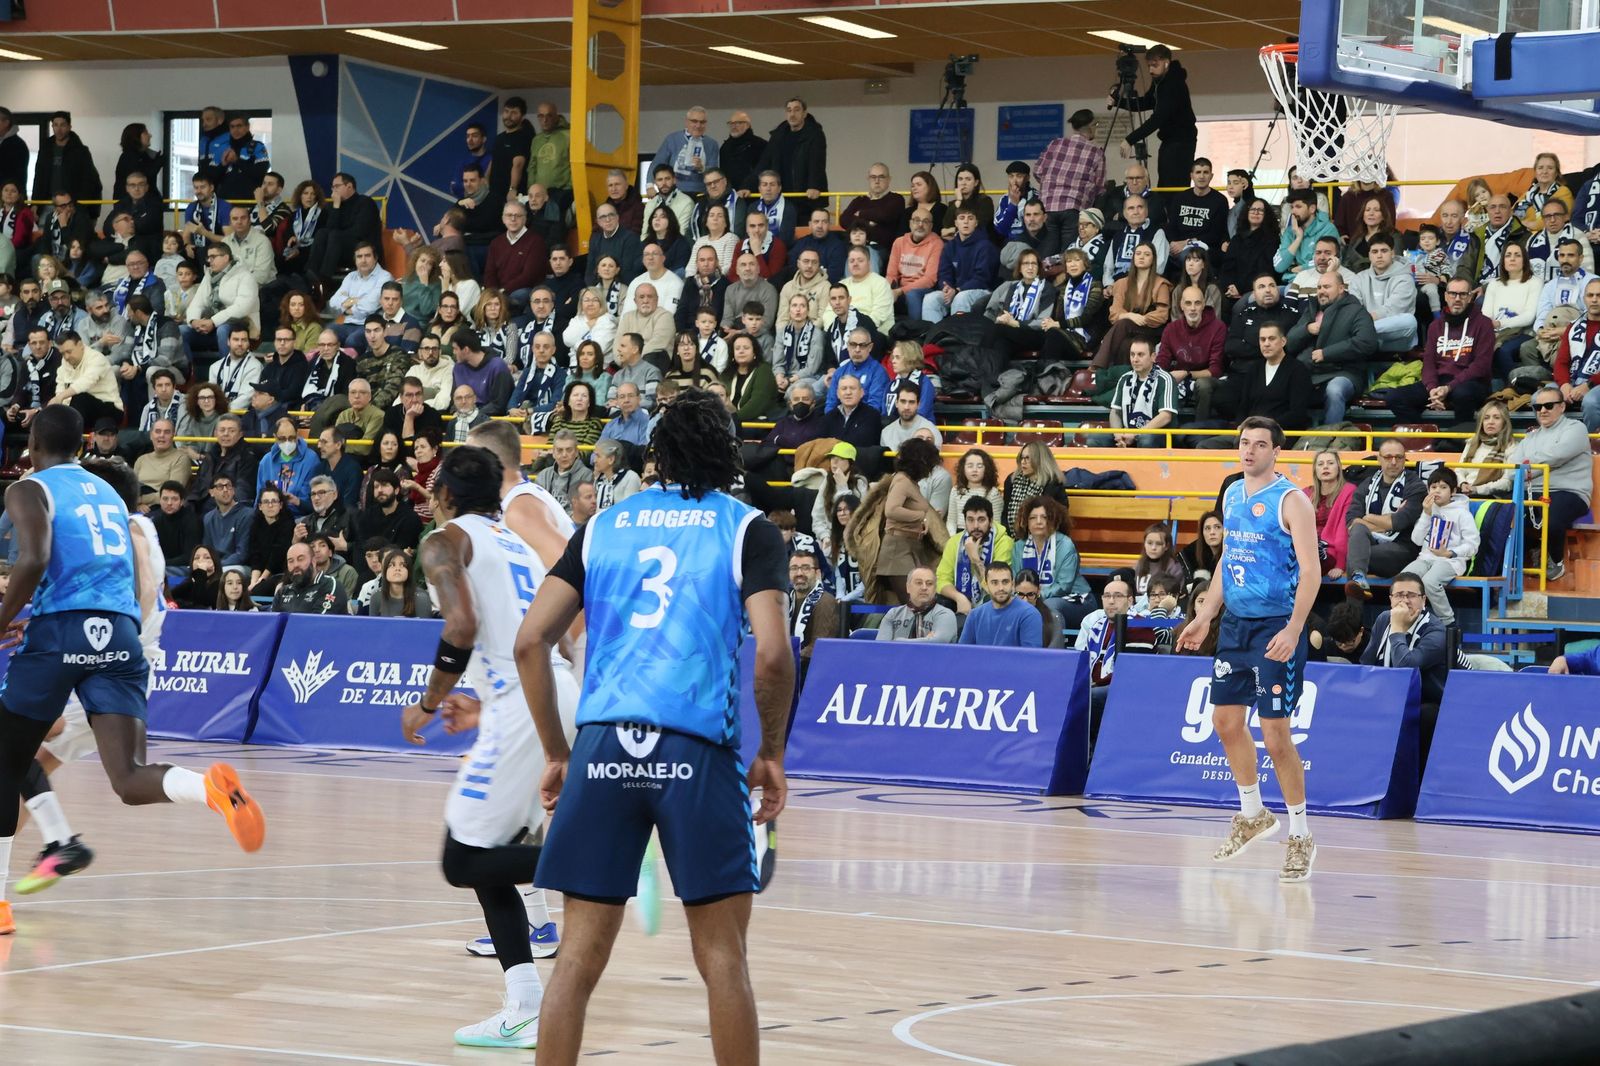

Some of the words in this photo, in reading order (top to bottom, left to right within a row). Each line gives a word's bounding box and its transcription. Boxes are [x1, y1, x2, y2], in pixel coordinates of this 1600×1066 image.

[1179, 205, 1210, 220] BETTER
[1182, 216, 1204, 227] DAYS
[75, 503, 127, 556] 15
[615, 511, 632, 529] C.
[636, 509, 717, 529] ROGERS
[629, 545, 678, 629] 3
[1227, 563, 1246, 587] 13
[172, 651, 251, 675] RURAL
[346, 661, 402, 686] CAJA
[340, 688, 367, 704] DE
[370, 689, 426, 706] ZAMO
[816, 683, 1039, 733] ALIMERKA
[587, 762, 694, 780] MORALEJO
